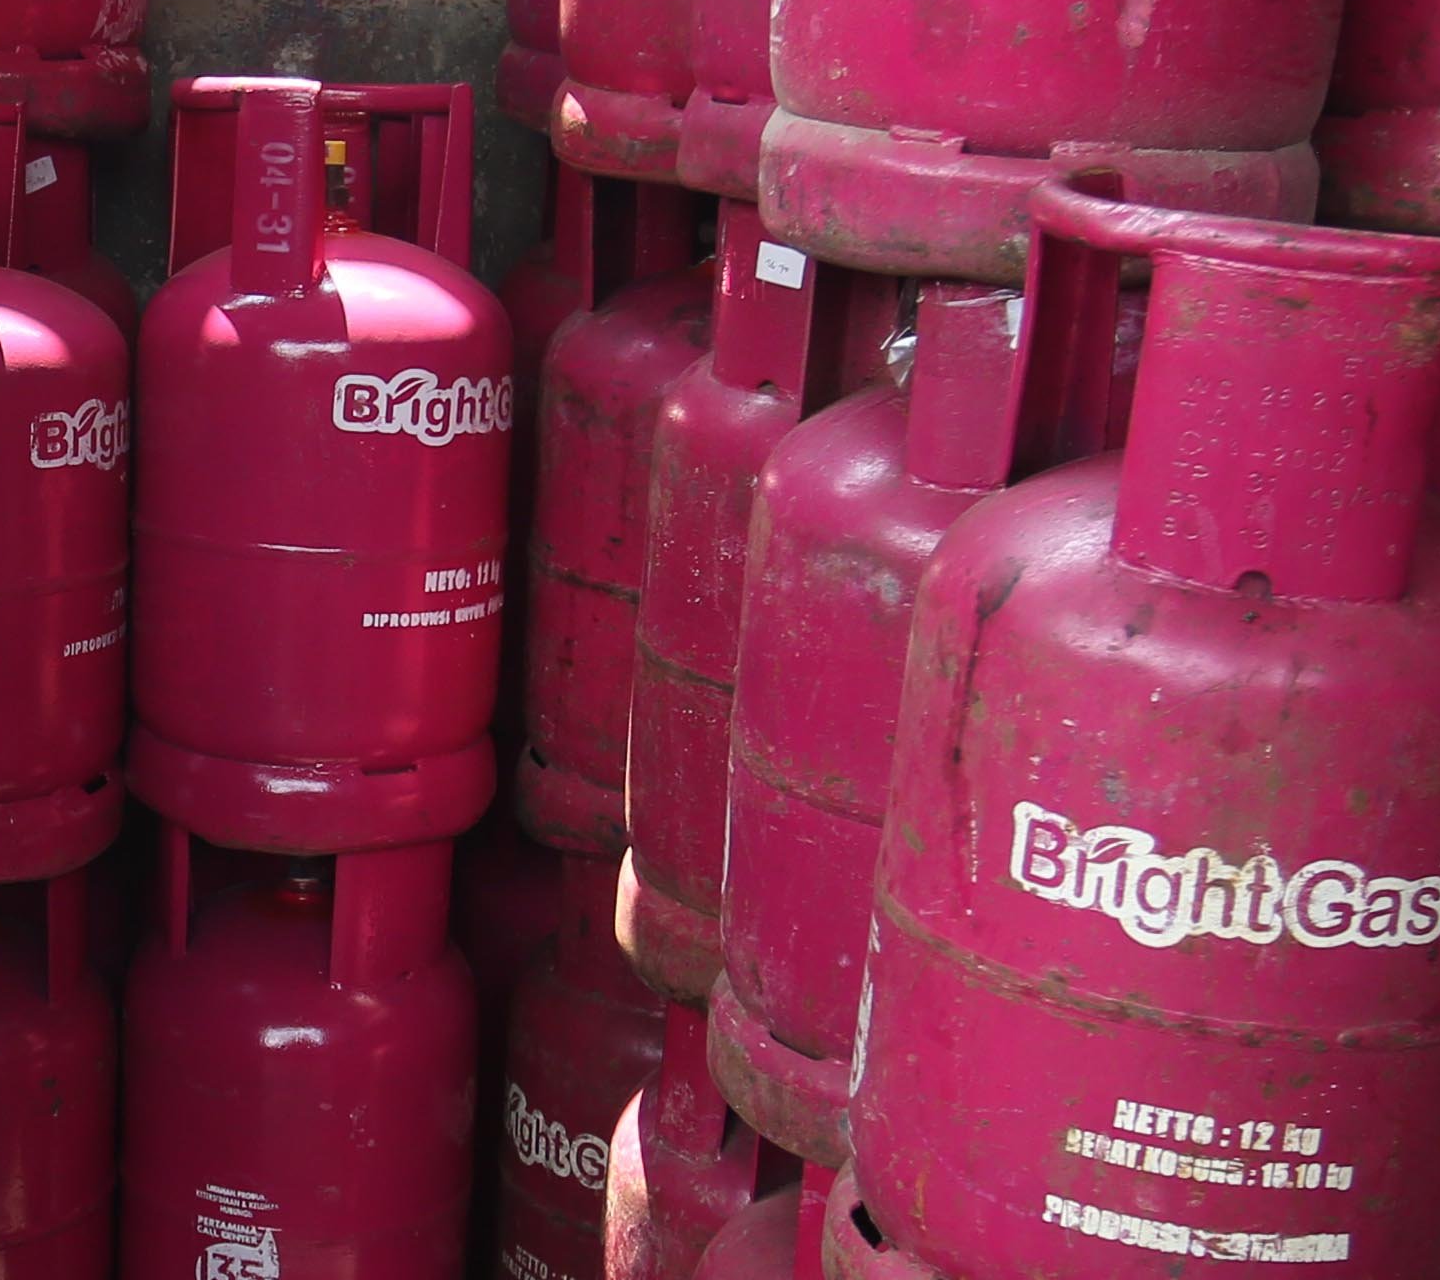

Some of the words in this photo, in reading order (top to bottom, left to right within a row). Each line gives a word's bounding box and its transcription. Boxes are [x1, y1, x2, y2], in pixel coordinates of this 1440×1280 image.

[255, 140, 296, 255] 04-31
[334, 369, 494, 446] Bright
[362, 610, 451, 628] DIPRODUKSI
[1011, 801, 1283, 948] Bright
[1113, 1099, 1215, 1145] NETTO
[1238, 1121, 1275, 1151] 12
[1282, 1123, 1322, 1156] kg
[1260, 1162, 1321, 1189] 15.10
[1324, 1162, 1354, 1190] kg
[196, 1224, 221, 1238] CALL
[221, 1230, 260, 1246] CENTER
[197, 1214, 260, 1235] PERTAMINA
